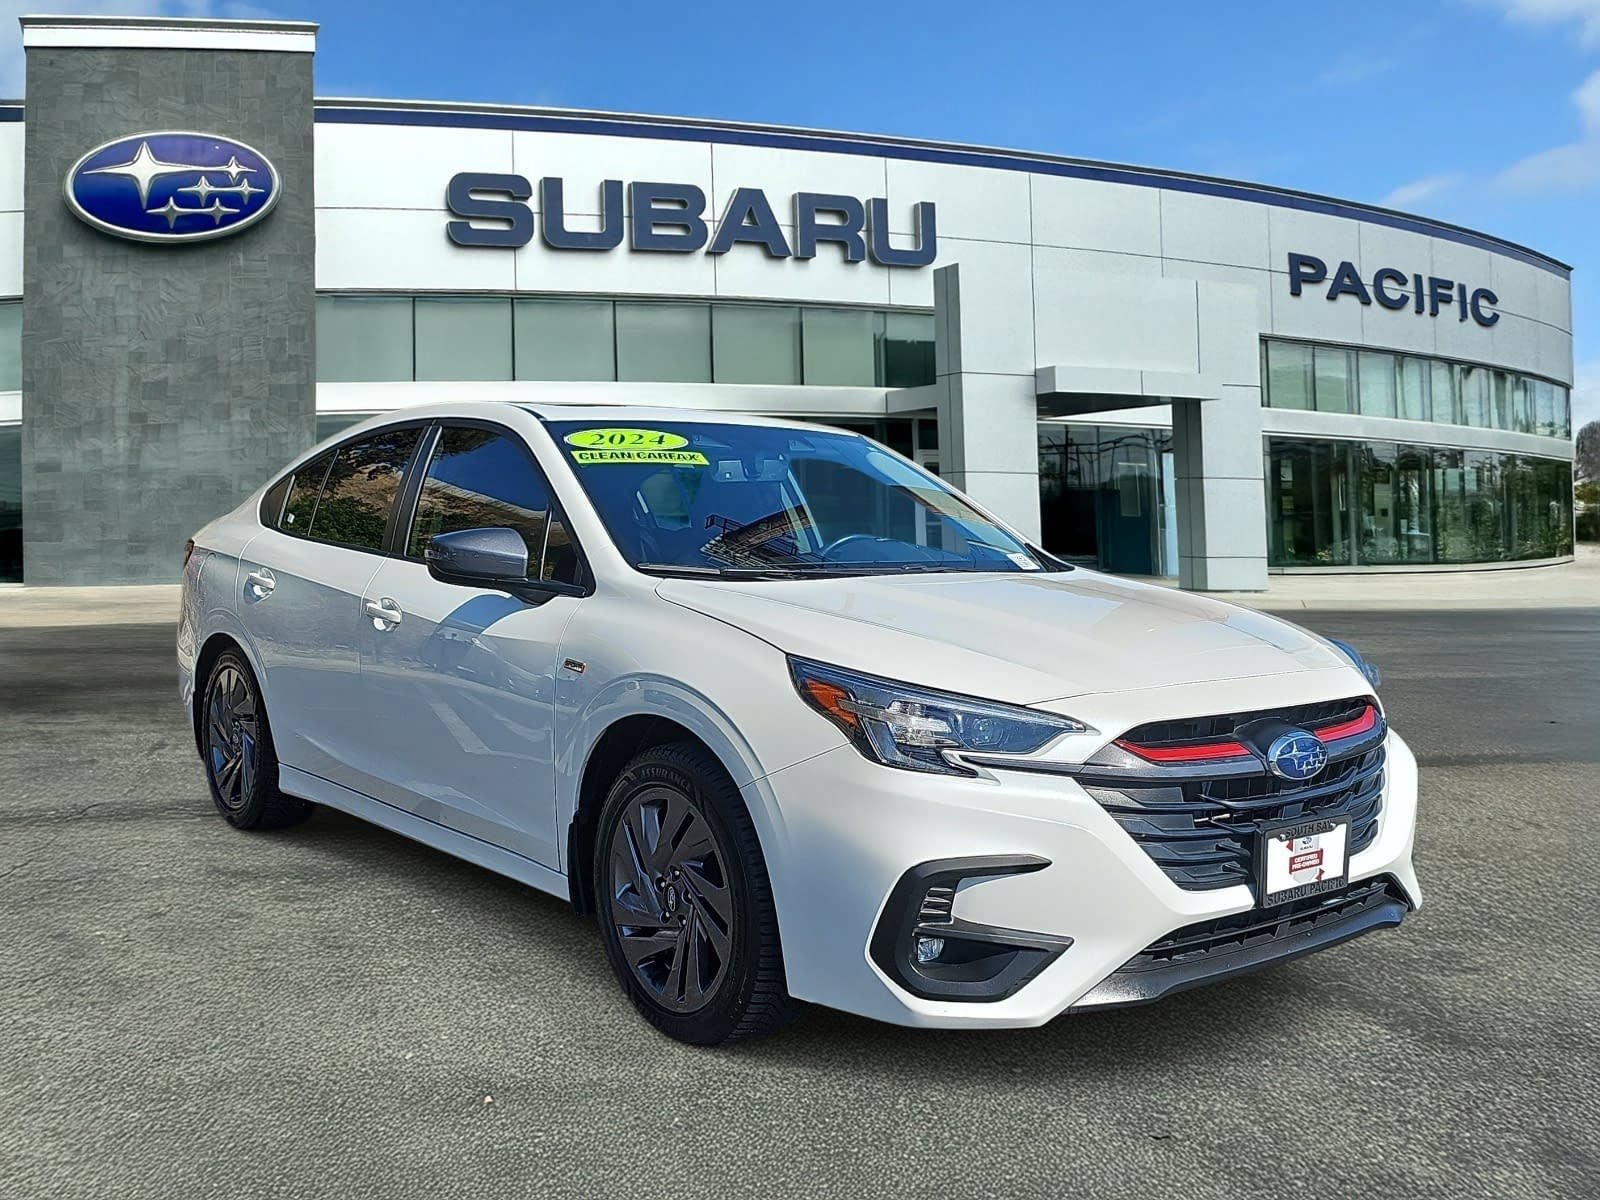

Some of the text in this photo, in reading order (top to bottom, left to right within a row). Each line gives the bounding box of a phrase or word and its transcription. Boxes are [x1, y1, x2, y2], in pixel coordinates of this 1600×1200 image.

[447, 171, 937, 267] SUBARU
[1288, 252, 1500, 327] PACIFIC
[589, 433, 666, 446] 2024
[578, 451, 698, 462] CLEAN CARFAX
[1286, 820, 1333, 839] SOUTH BAY
[1291, 859, 1320, 871] PRE-OWNED
[1294, 853, 1318, 863] CERTIFIED
[1267, 878, 1345, 905] SUBARU PACIFIC
